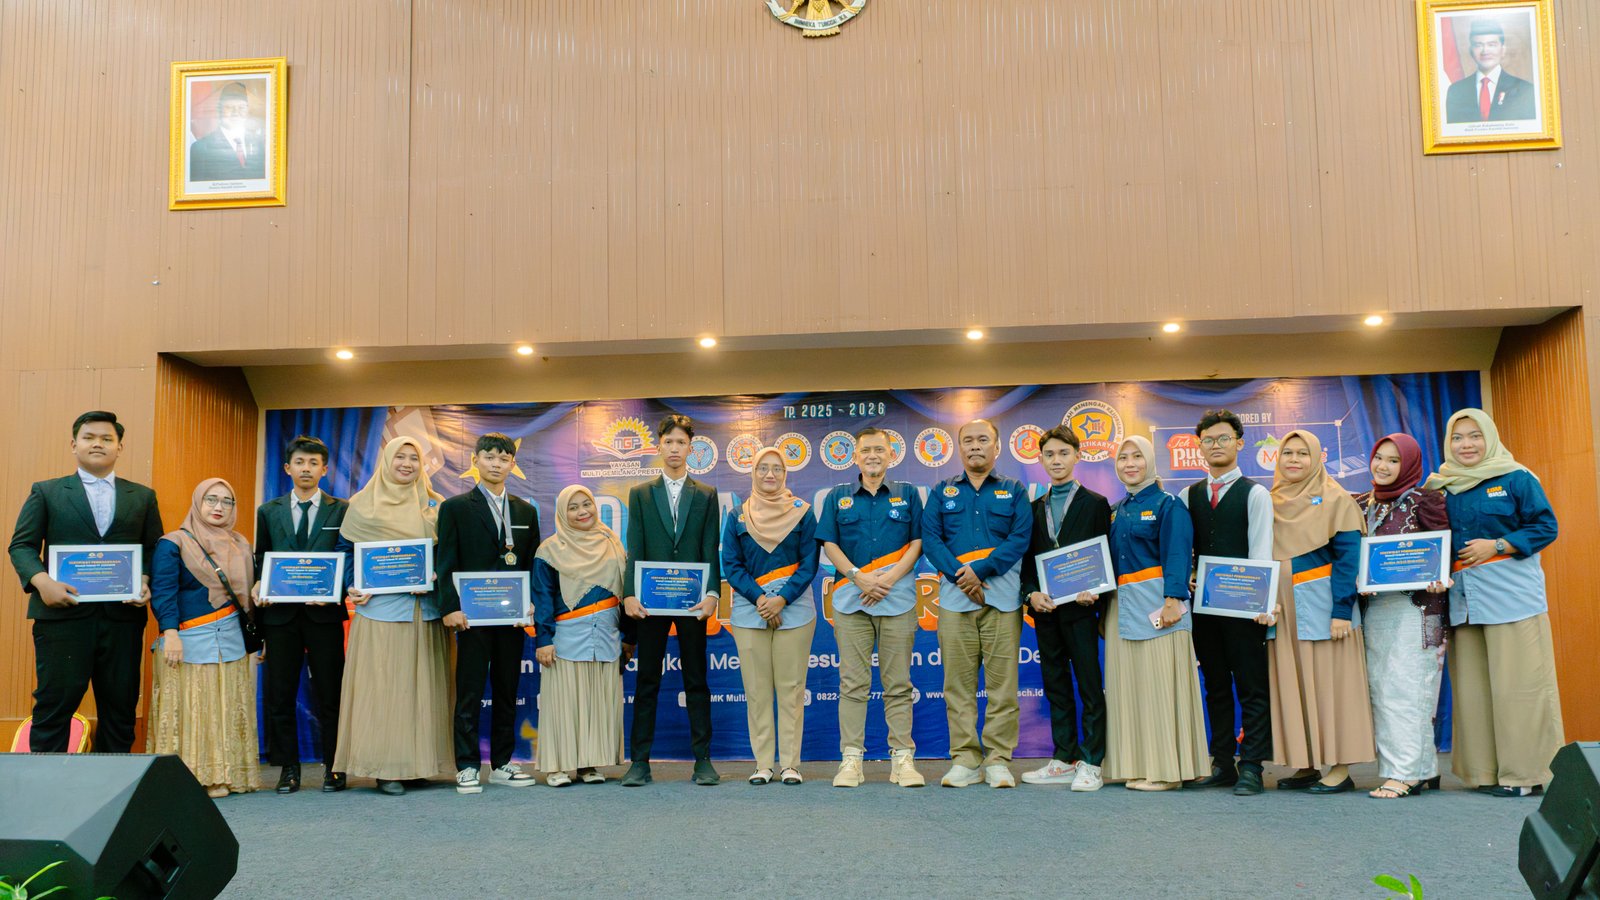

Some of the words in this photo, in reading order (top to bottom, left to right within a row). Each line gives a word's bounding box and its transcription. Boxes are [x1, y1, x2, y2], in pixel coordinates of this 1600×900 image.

[783, 406, 796, 418] TP.
[801, 404, 832, 418] 2025
[849, 402, 886, 416] 2026
[1262, 412, 1271, 423] BY
[1080, 441, 1115, 450] ULTIKARYA
[602, 469, 636, 477] GEMILANG
